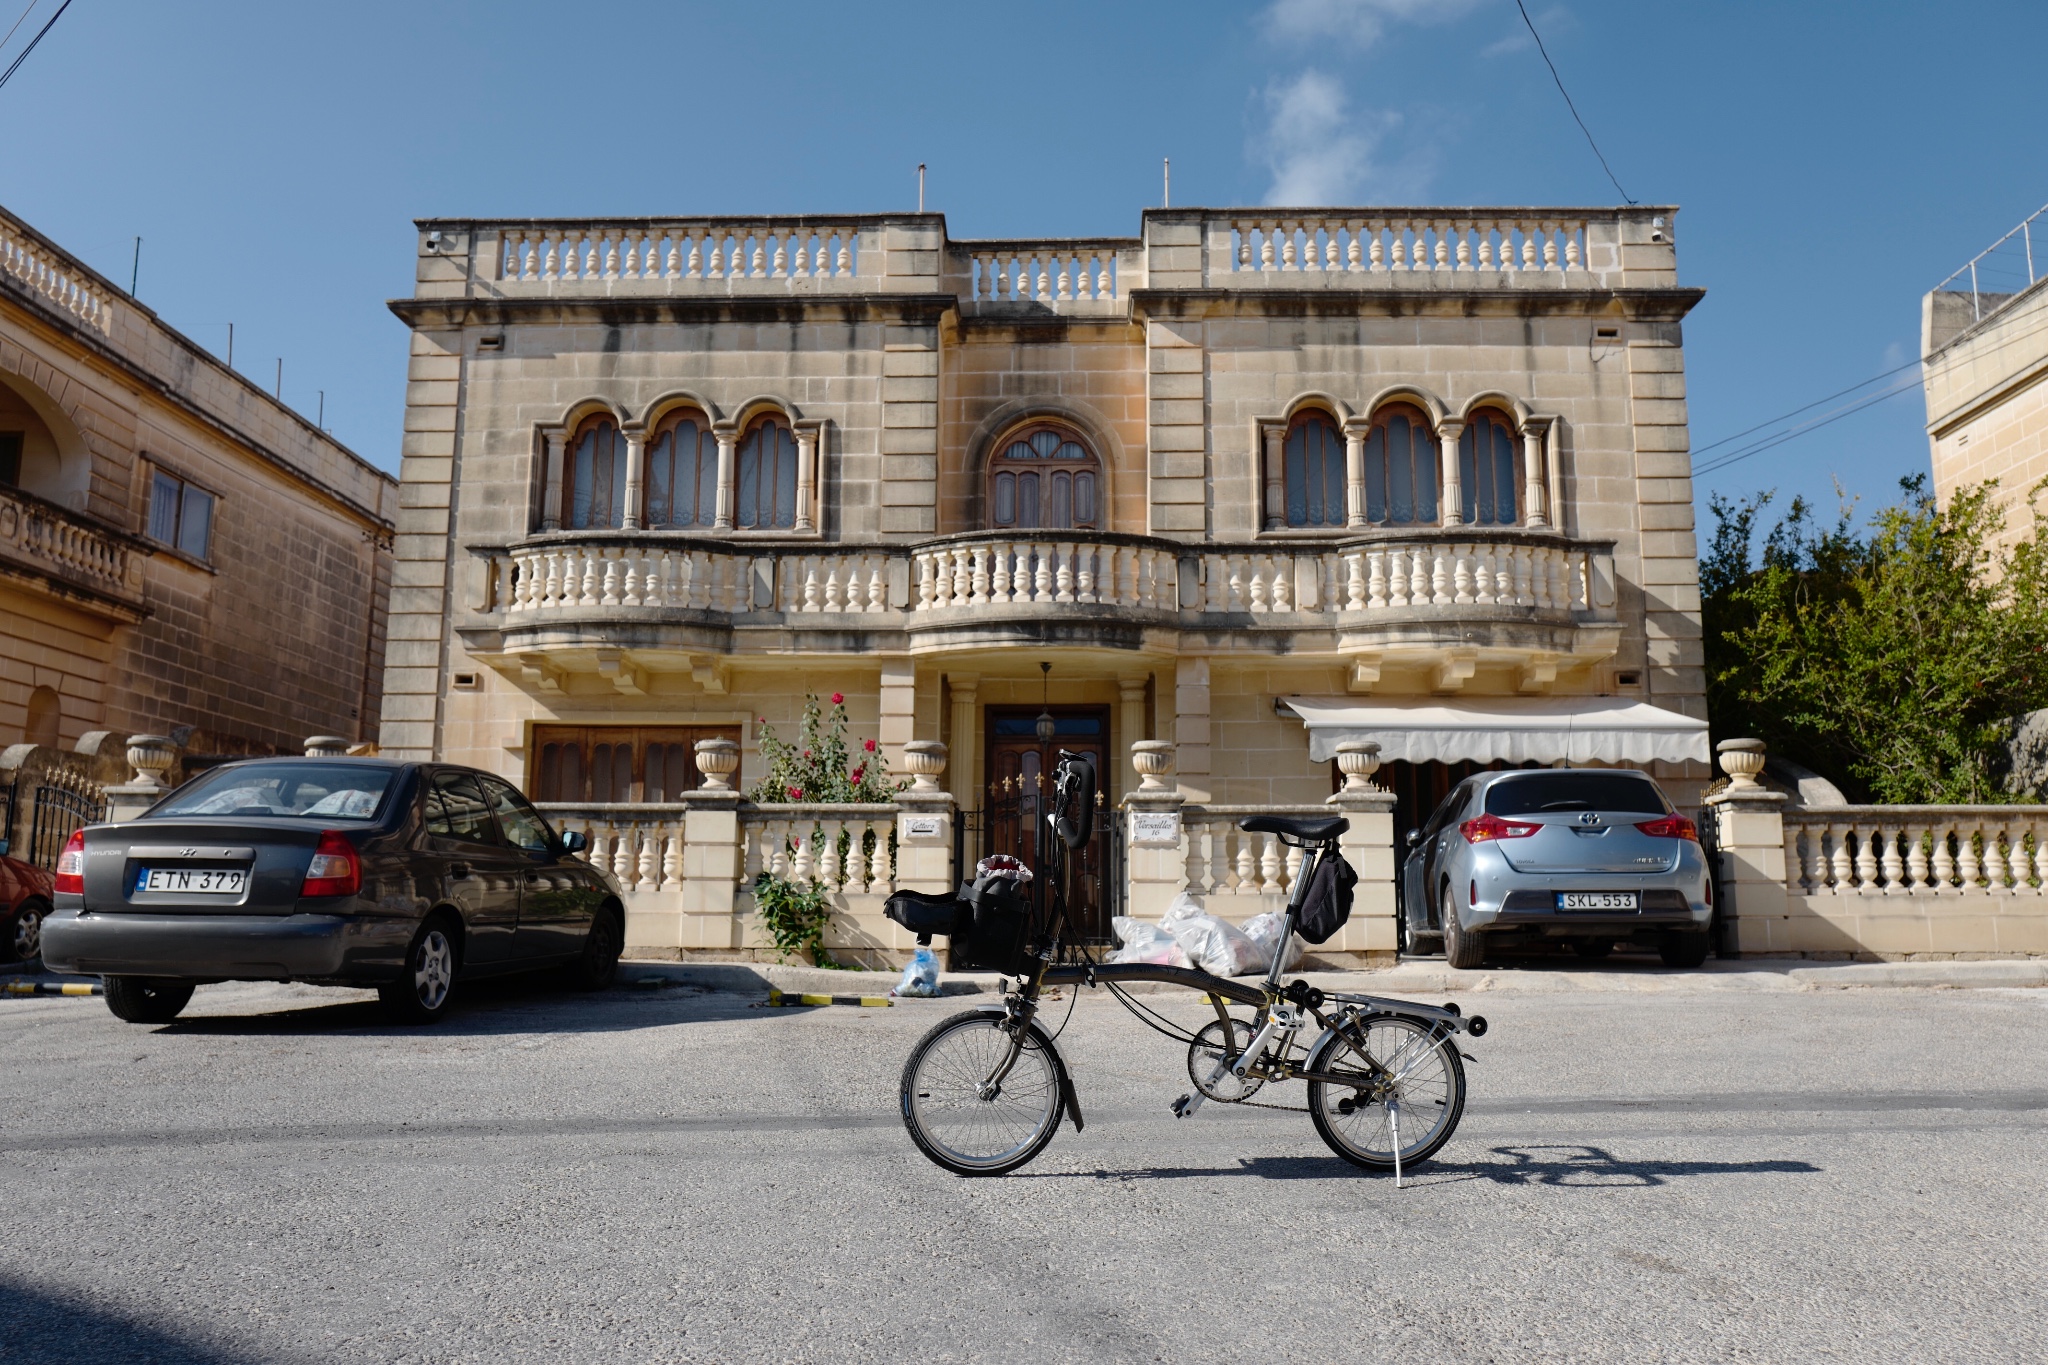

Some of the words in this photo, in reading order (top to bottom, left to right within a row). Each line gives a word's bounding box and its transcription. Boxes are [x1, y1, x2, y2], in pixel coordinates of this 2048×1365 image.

[911, 821, 935, 830] Letters
[1137, 820, 1171, 829] Versailles
[149, 871, 191, 888] ETN
[200, 872, 241, 889] 379
[1567, 894, 1597, 907] SKL
[1603, 894, 1631, 907] 553
[1214, 980, 1255, 998] BROMPTON
